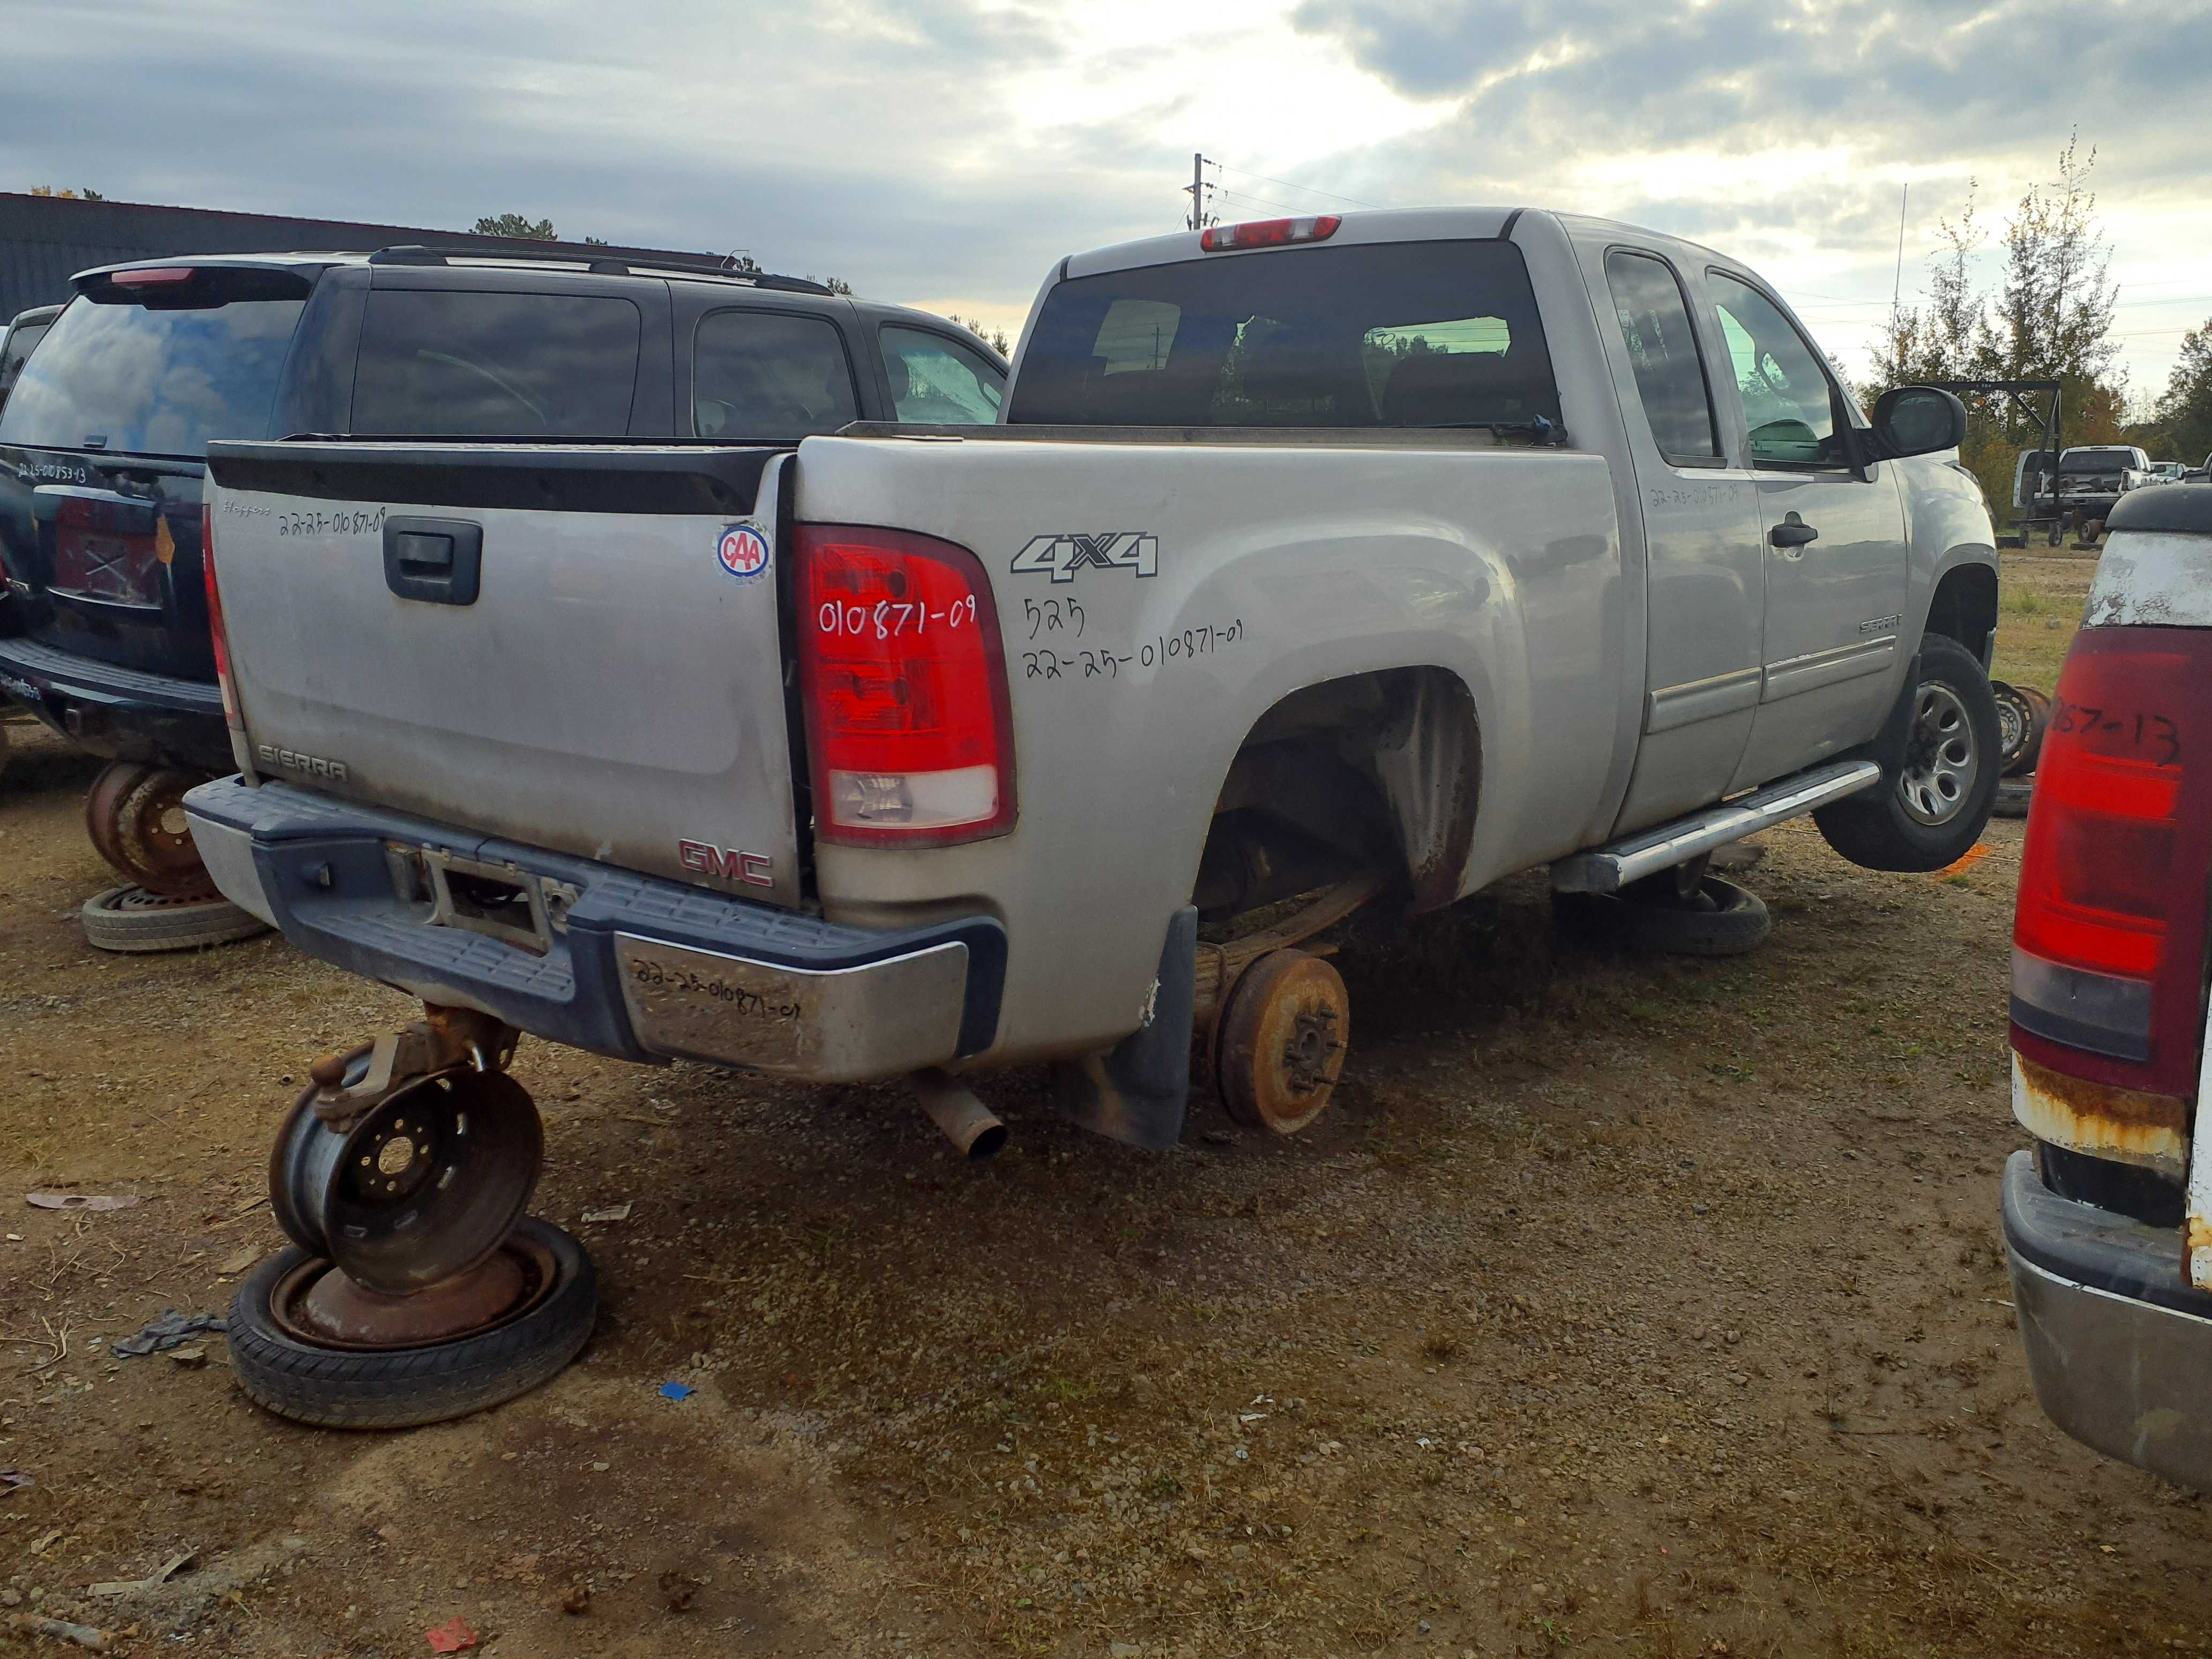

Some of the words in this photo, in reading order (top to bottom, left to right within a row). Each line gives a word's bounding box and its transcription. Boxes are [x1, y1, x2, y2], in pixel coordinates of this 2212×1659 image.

[723, 533, 761, 571] CAA
[819, 594, 977, 640] 010871-09
[1024, 597, 1085, 640] 525
[258, 744, 348, 781] SIERRA
[678, 838, 773, 887] GMC
